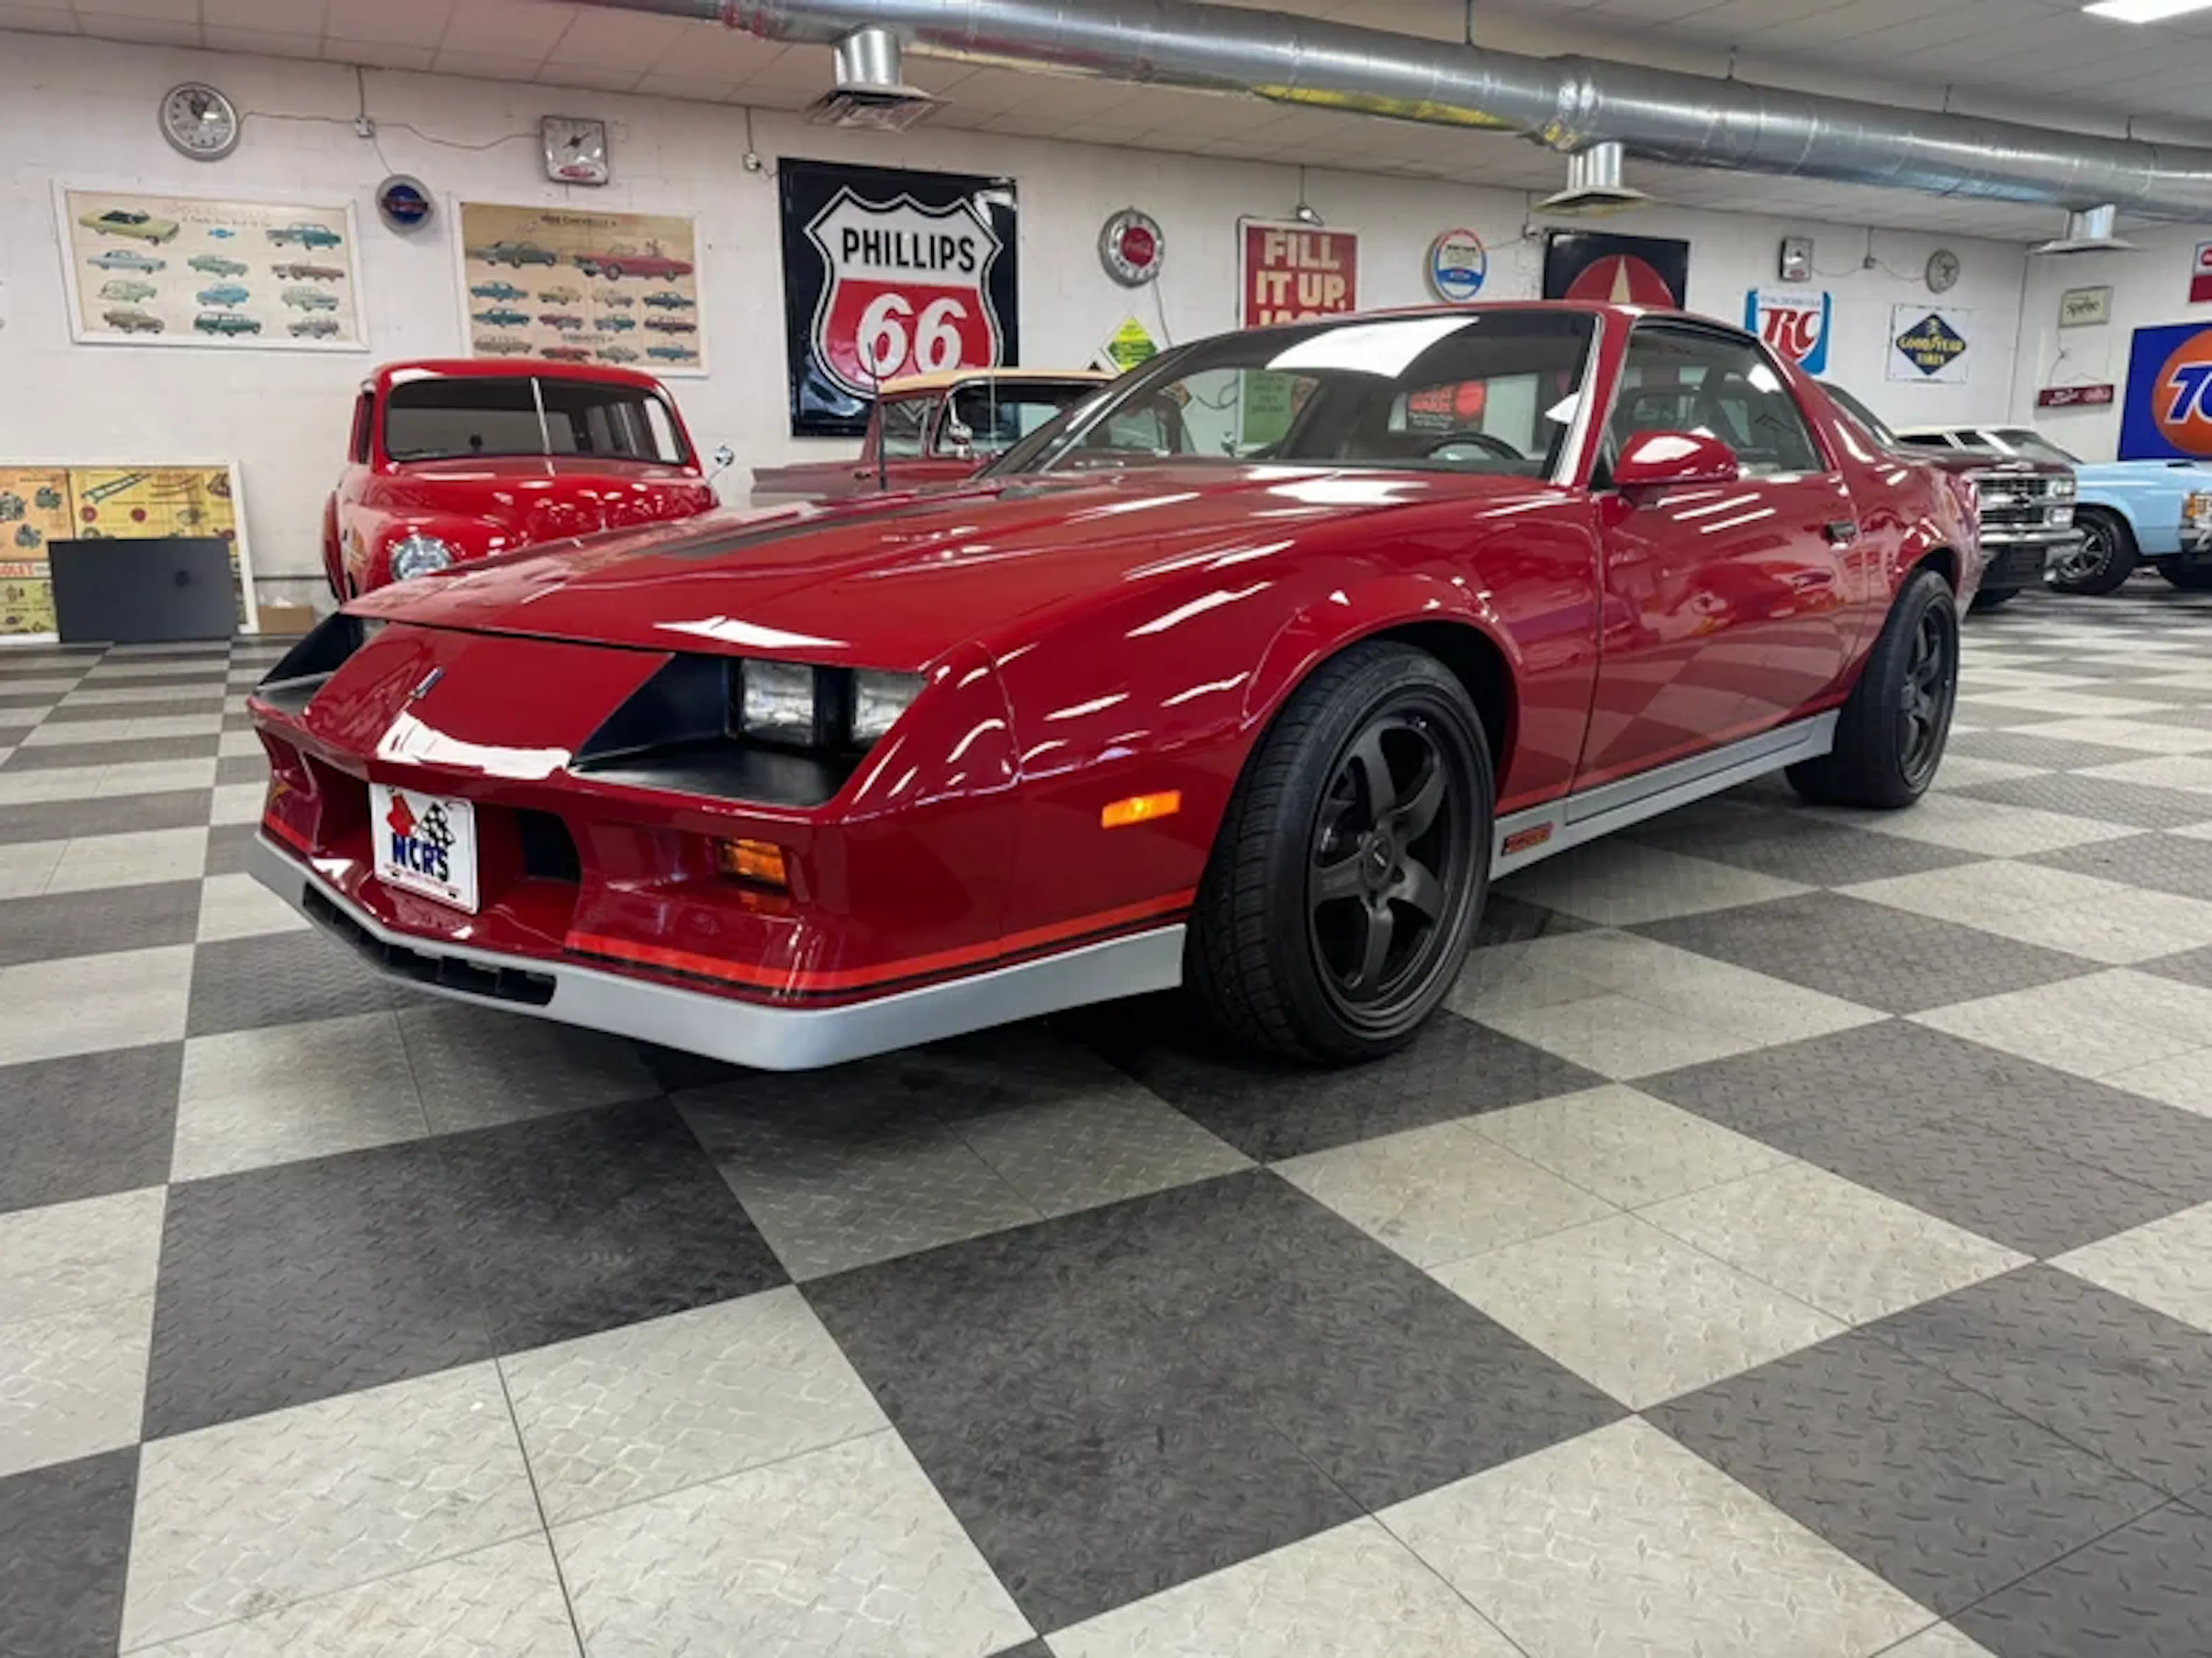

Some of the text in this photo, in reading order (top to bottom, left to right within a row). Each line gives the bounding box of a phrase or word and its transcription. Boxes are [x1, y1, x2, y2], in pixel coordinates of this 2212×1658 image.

[842, 227, 975, 273] PHILLIPS
[1264, 231, 1341, 270] FILL
[1256, 270, 1292, 306] IT
[855, 292, 969, 379] 66
